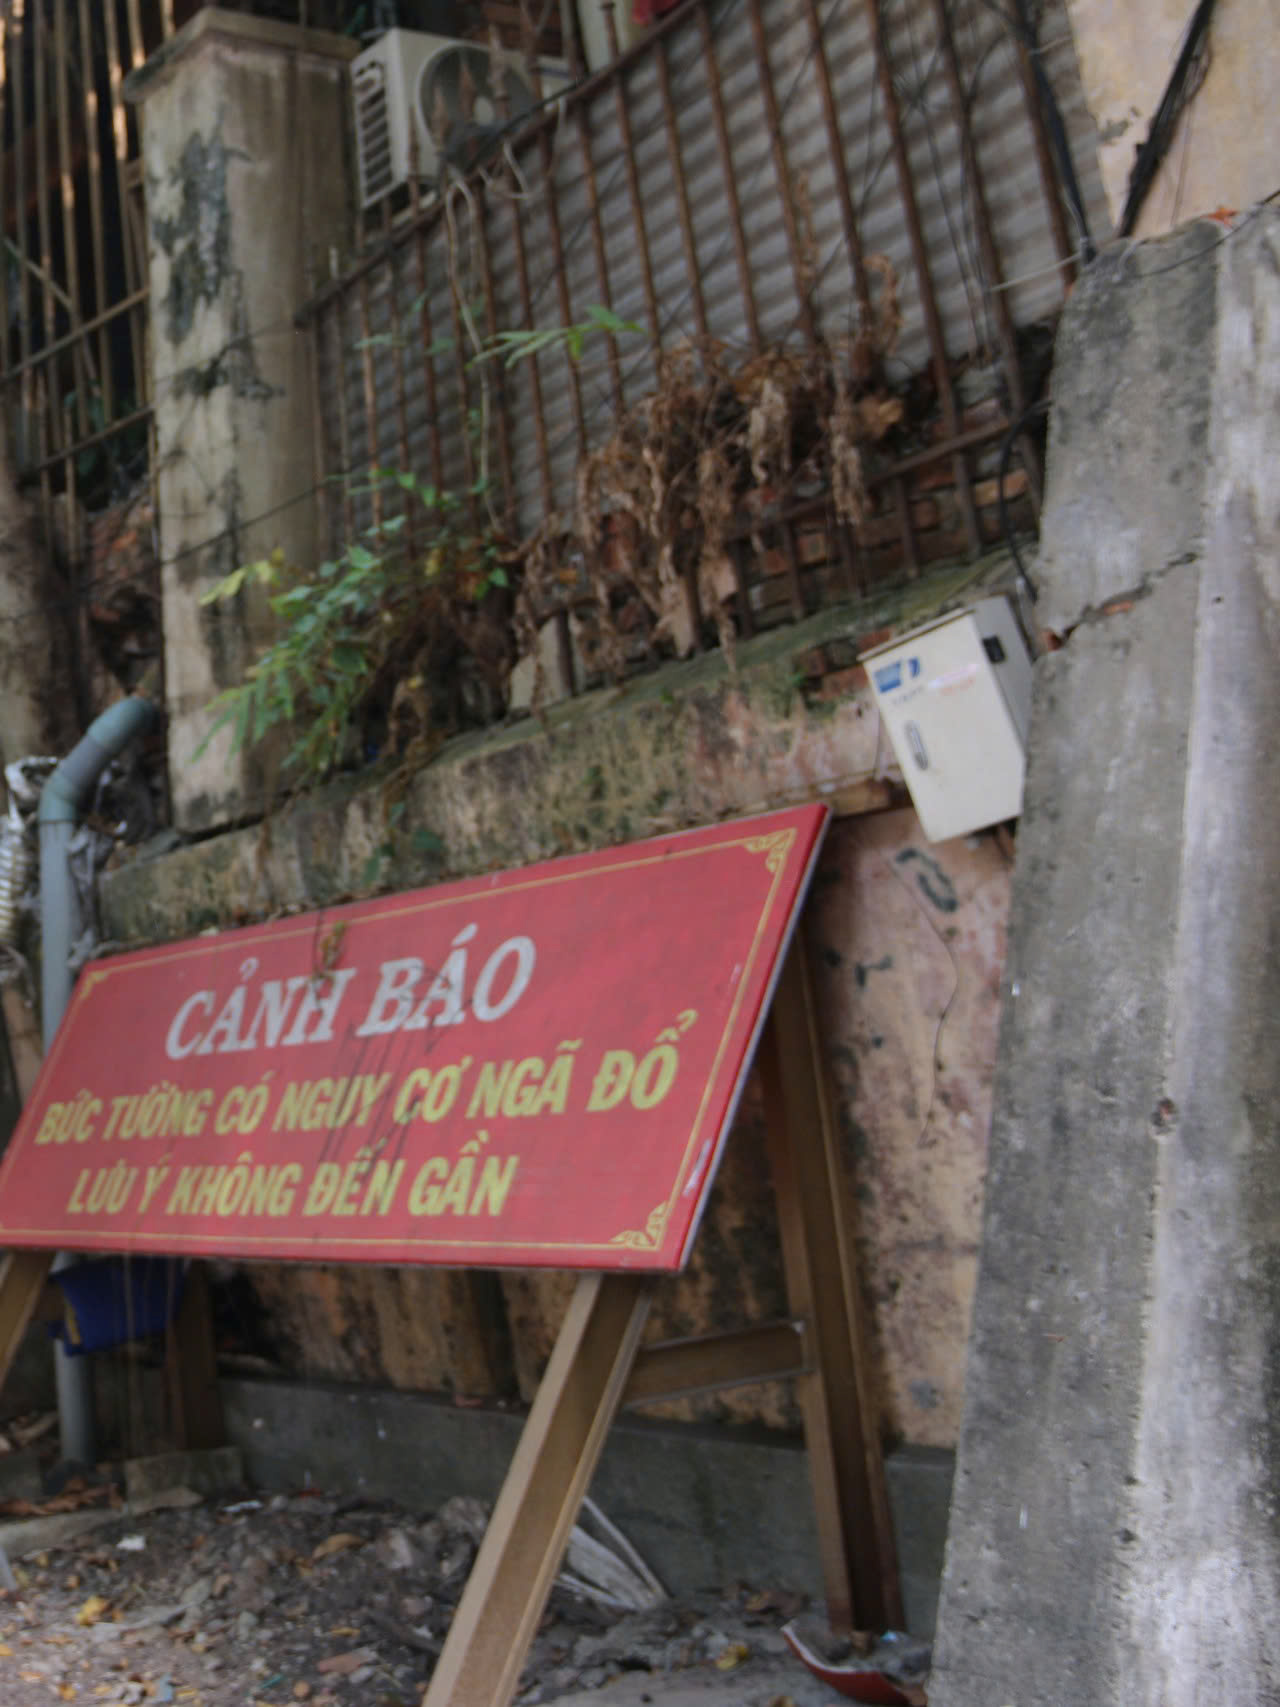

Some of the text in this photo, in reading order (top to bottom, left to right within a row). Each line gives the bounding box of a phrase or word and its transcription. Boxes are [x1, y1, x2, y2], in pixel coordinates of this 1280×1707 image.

[165, 923, 537, 1061] CẢNH BÁO
[34, 1008, 699, 1145] BỨC TƯỜNG CÓ NGUY CƠ NGÃ ĐỔ
[67, 1129, 519, 1216] LƯU Ý KHÔNG ĐẾN GẦN
